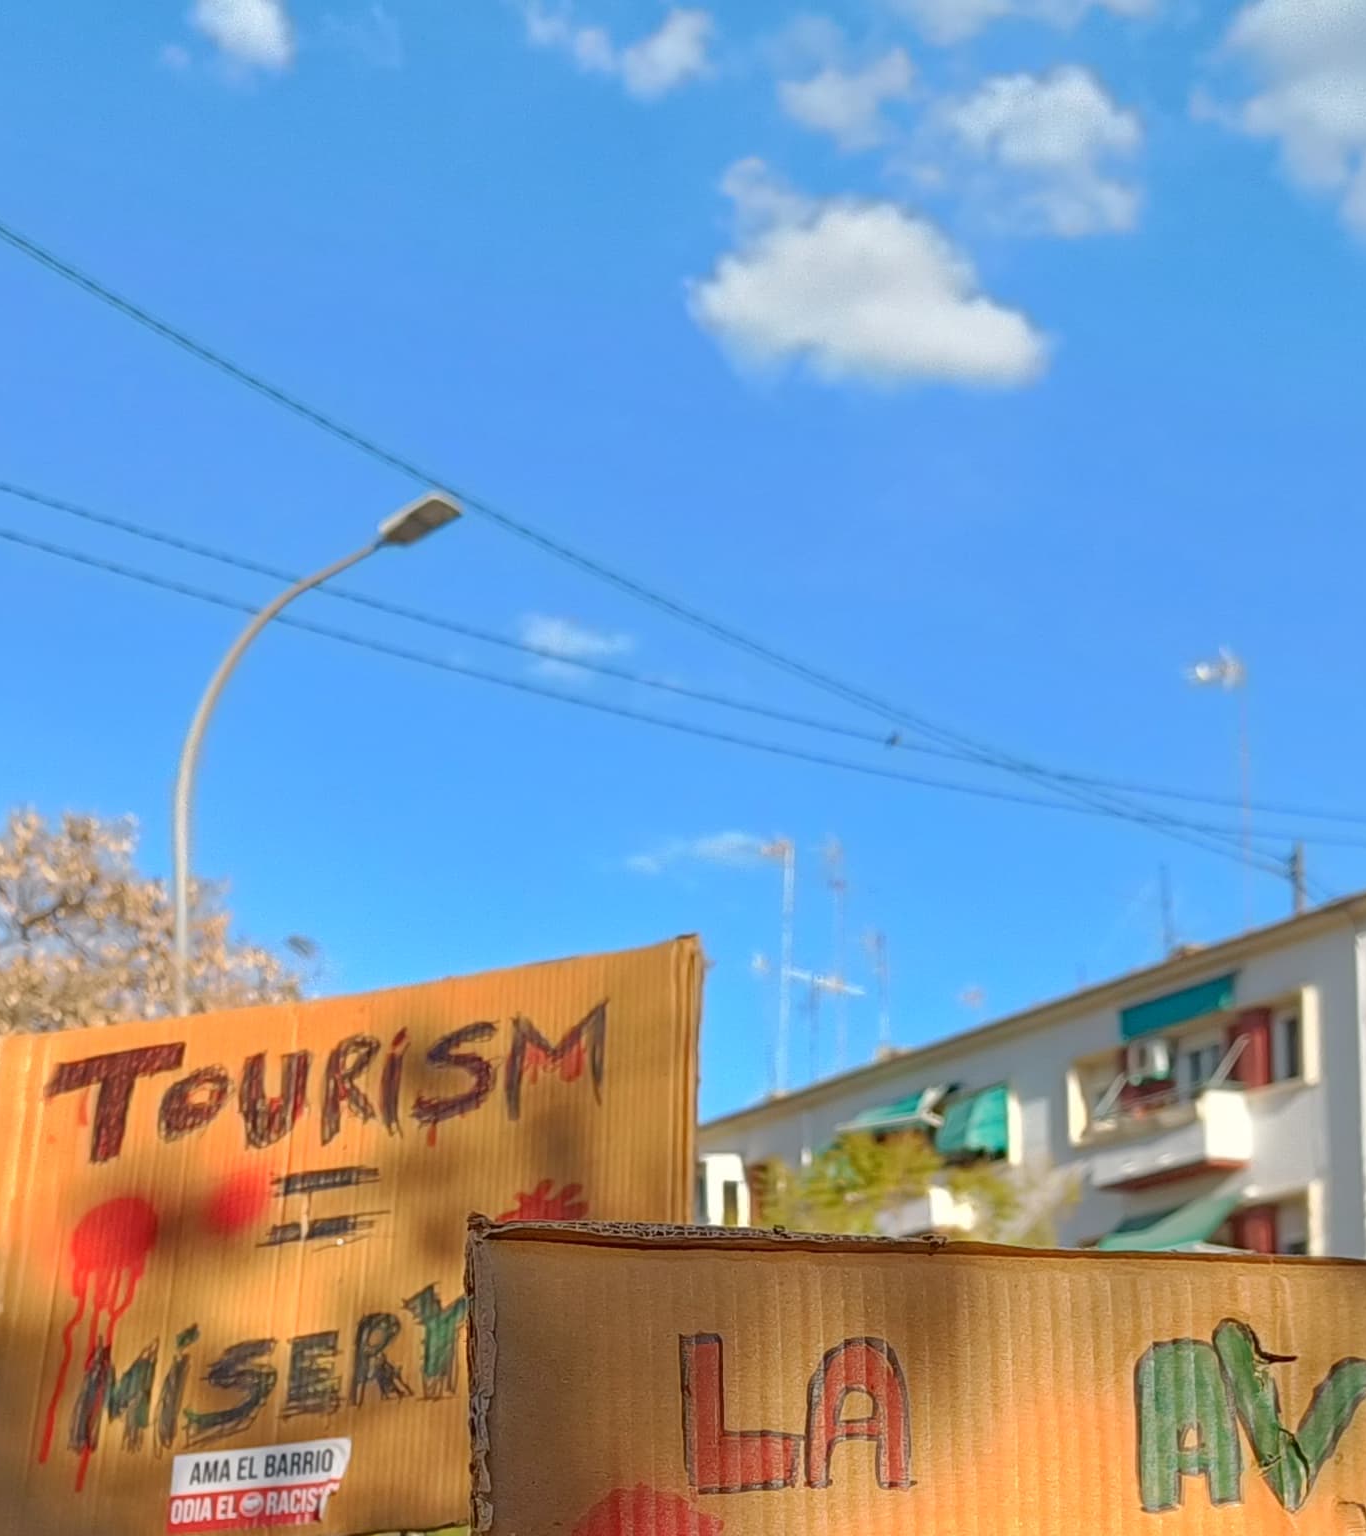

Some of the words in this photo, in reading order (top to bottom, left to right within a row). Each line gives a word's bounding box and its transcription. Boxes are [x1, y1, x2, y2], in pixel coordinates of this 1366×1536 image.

[678, 1332, 917, 1496] LA
[189, 1459, 231, 1486] AMA
[236, 1456, 258, 1481] EL
[264, 1448, 334, 1479] BARRIO
[170, 1497, 213, 1525] ODIA
[216, 1495, 238, 1520] EL
